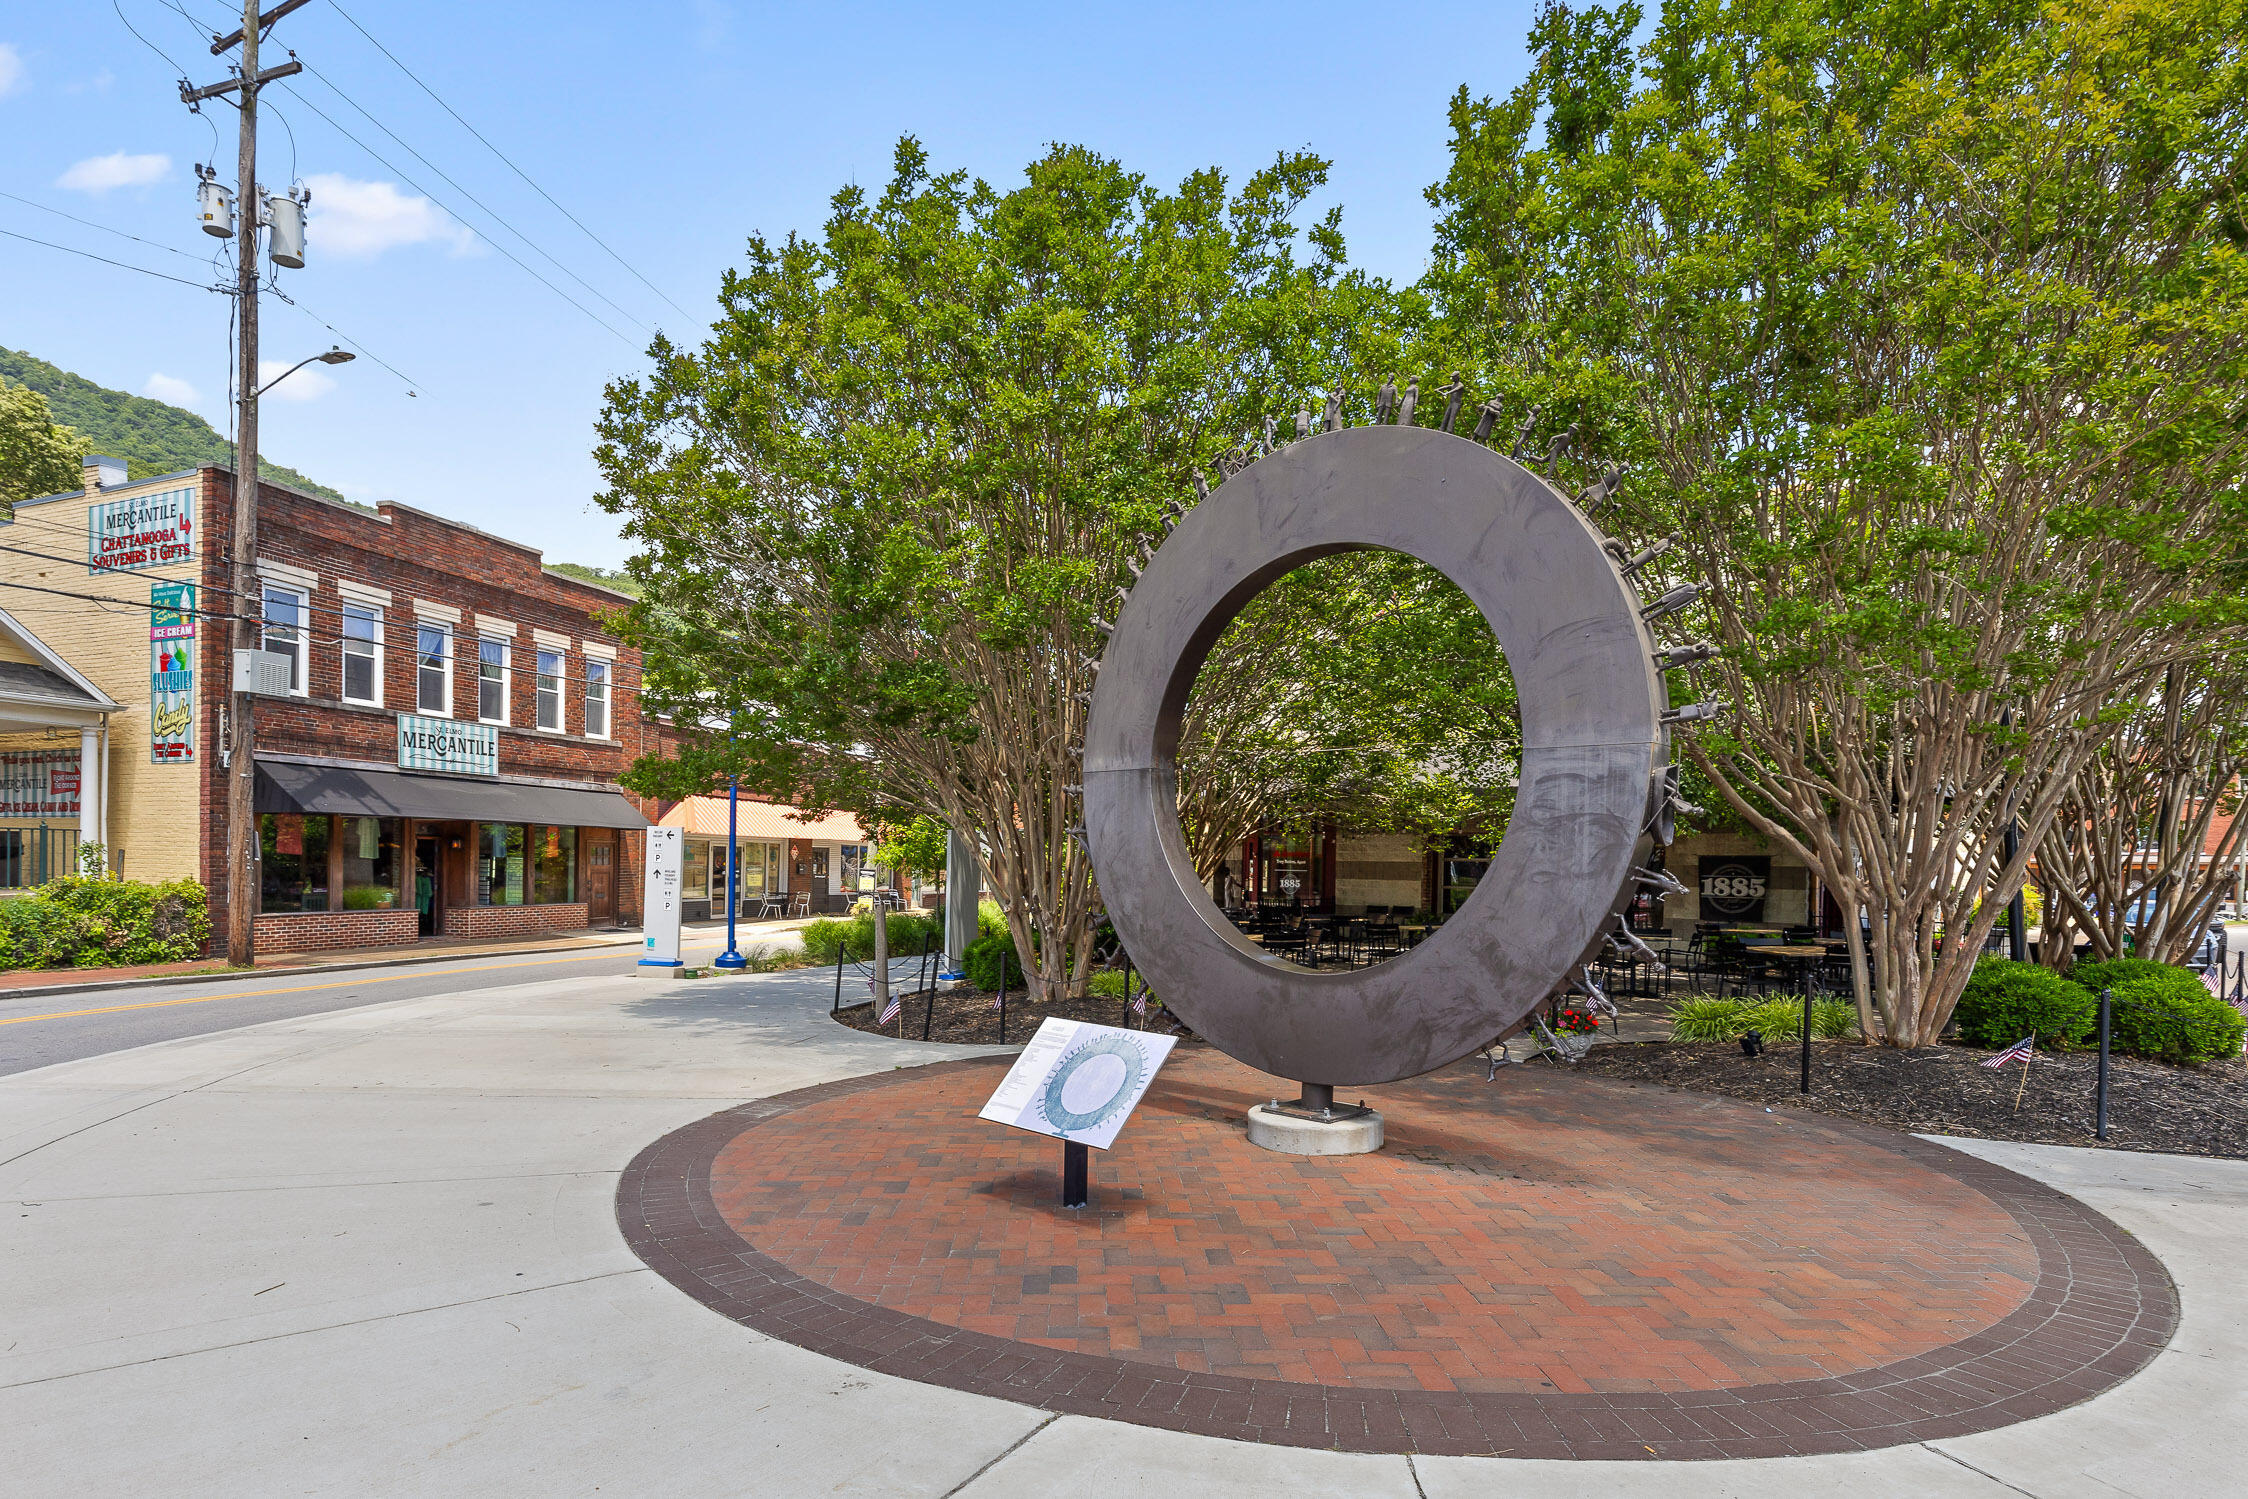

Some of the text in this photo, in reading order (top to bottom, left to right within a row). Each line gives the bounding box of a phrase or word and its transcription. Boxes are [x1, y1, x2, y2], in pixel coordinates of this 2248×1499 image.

[106, 504, 177, 530] MERCANTILE
[101, 528, 177, 552] CHATTANOOGA
[93, 549, 147, 570] SOUVENIRS
[160, 543, 190, 560] GIFTS
[154, 626, 193, 638] ICE CREAM
[153, 670, 192, 691] SLUSHIES
[153, 698, 192, 737] Candy
[402, 731, 495, 756] MERCANTILE
[0, 778, 47, 793] MERCANTILE
[1280, 879, 1301, 888] 1885
[1700, 877, 1766, 898] 1885
